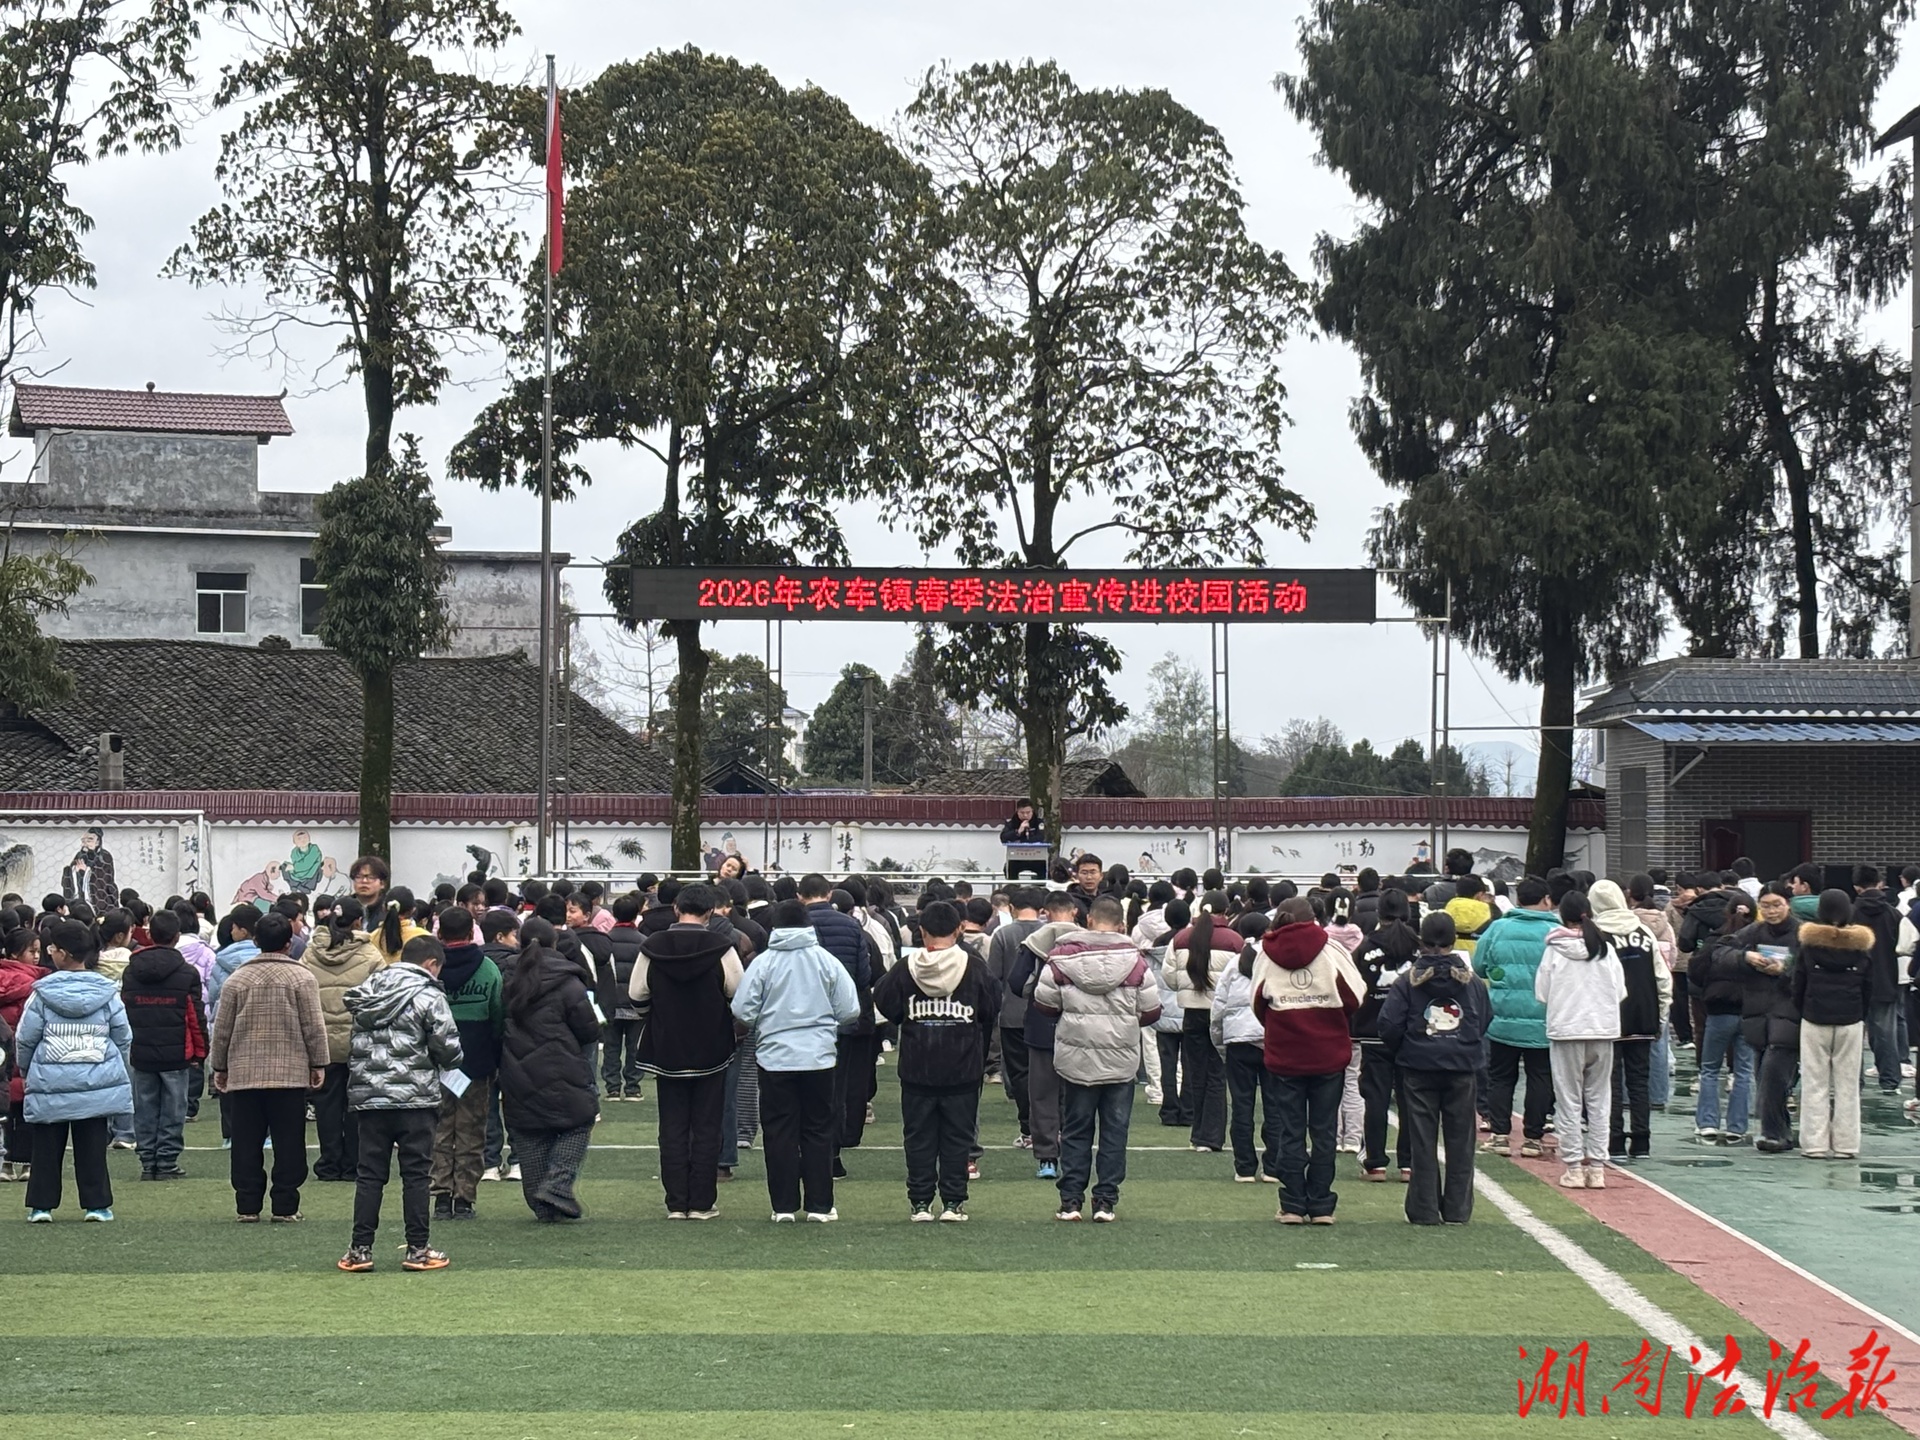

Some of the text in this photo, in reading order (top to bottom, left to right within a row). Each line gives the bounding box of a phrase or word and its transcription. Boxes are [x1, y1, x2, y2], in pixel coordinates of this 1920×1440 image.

[699, 575, 1307, 614] 2026年农车镇春季法治宣传进校园活动
[1612, 931, 1652, 952] NGE
